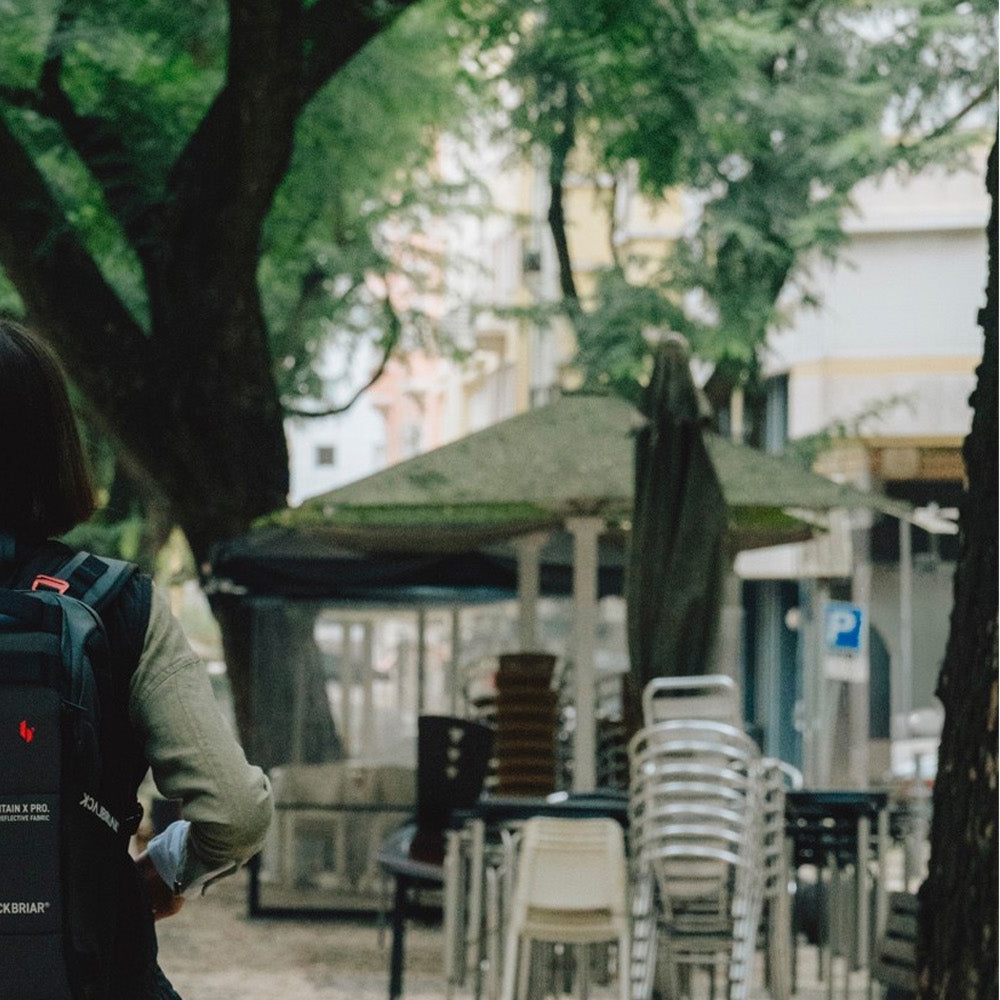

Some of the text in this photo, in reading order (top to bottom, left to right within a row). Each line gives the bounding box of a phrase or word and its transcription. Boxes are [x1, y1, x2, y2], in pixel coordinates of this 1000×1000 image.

[826, 610, 857, 646] P
[22, 804, 29, 813] X
[30, 803, 50, 813] PRO.
[29, 814, 50, 822] FABRIC
